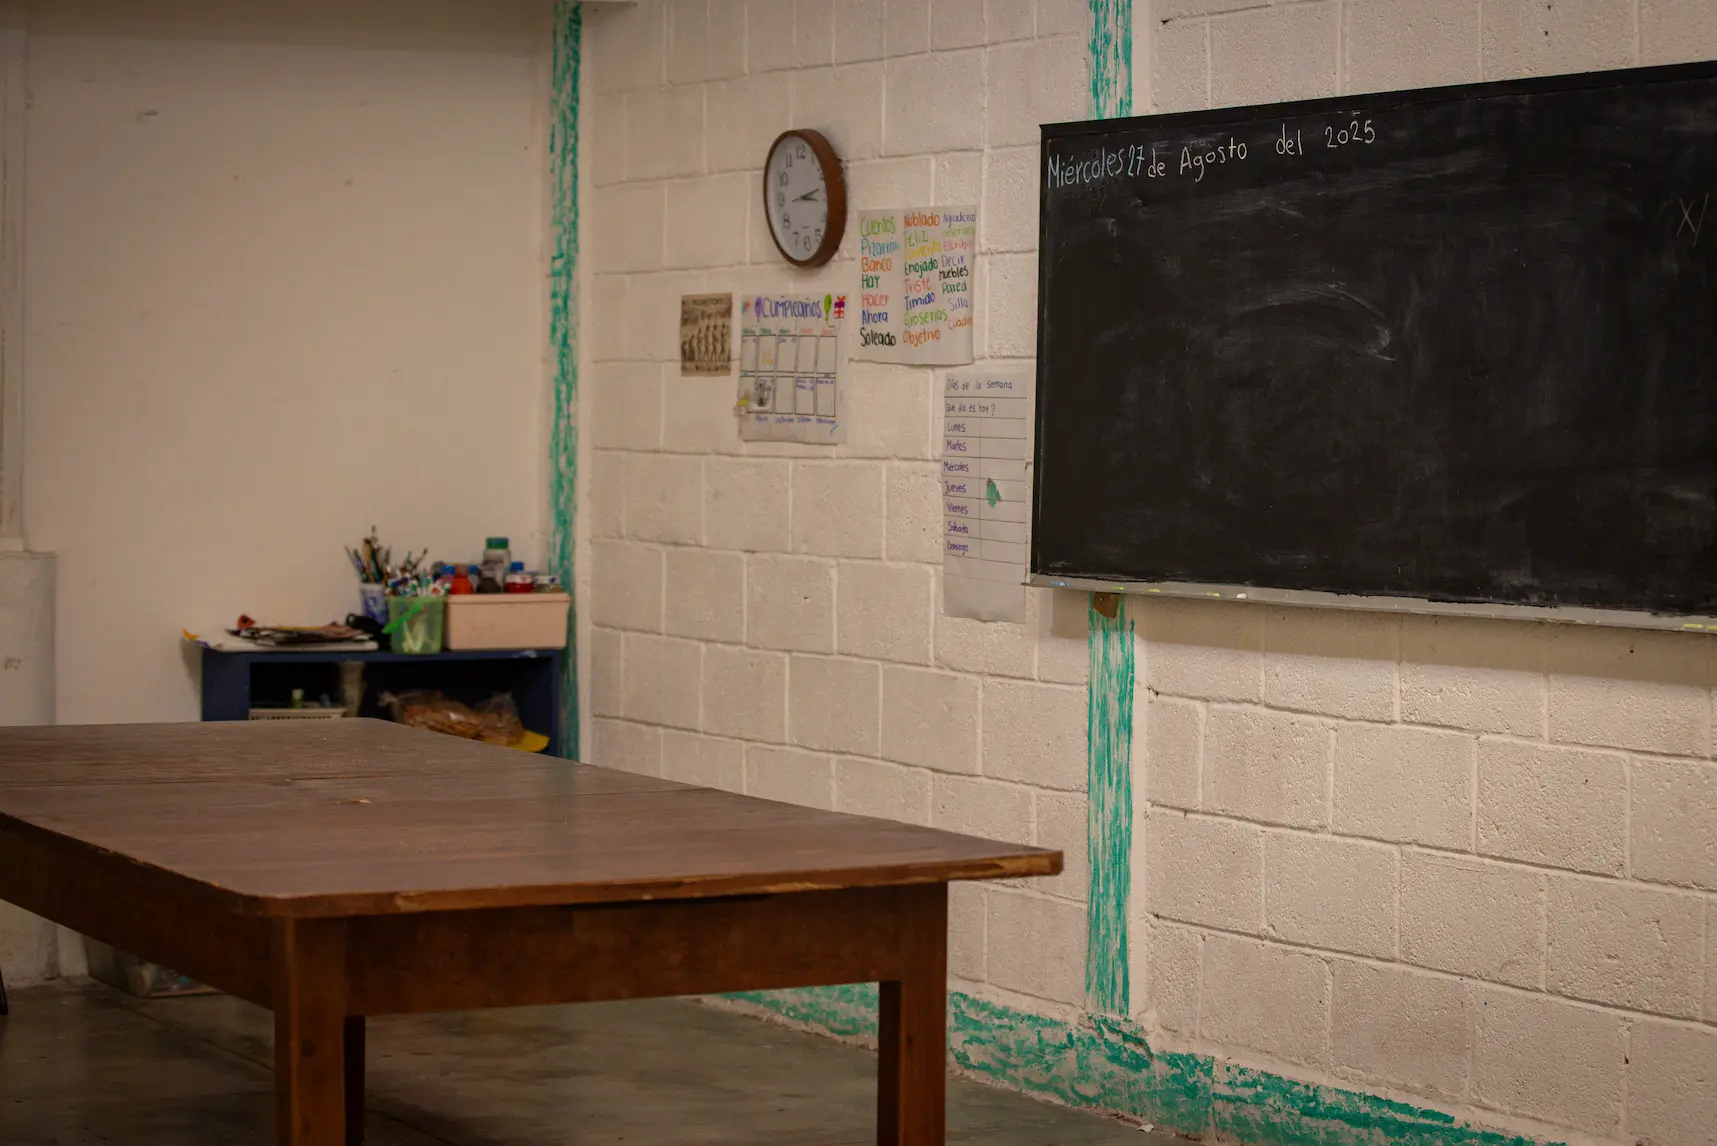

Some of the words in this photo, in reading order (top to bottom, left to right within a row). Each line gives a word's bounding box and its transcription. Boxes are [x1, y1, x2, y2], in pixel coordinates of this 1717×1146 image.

[1047, 147, 1124, 188] Miércoles
[1128, 144, 1145, 177] 27
[1148, 147, 1166, 178] de
[1179, 136, 1248, 183] Agosto
[1275, 123, 1303, 155] del
[1324, 118, 1375, 148] 2025
[861, 215, 896, 238] Cuentos
[904, 211, 940, 228] Nublado
[862, 256, 892, 272] Banco
[904, 257, 938, 279] Enojado
[942, 281, 966, 296] Pared
[862, 309, 888, 326] Ahora
[860, 326, 897, 347] Soleado
[947, 421, 966, 433] Lunes
[946, 439, 967, 451] Martes
[944, 481, 967, 495] Jueves
[946, 501, 969, 515] Viernes
[946, 539, 969, 555] Domingo
